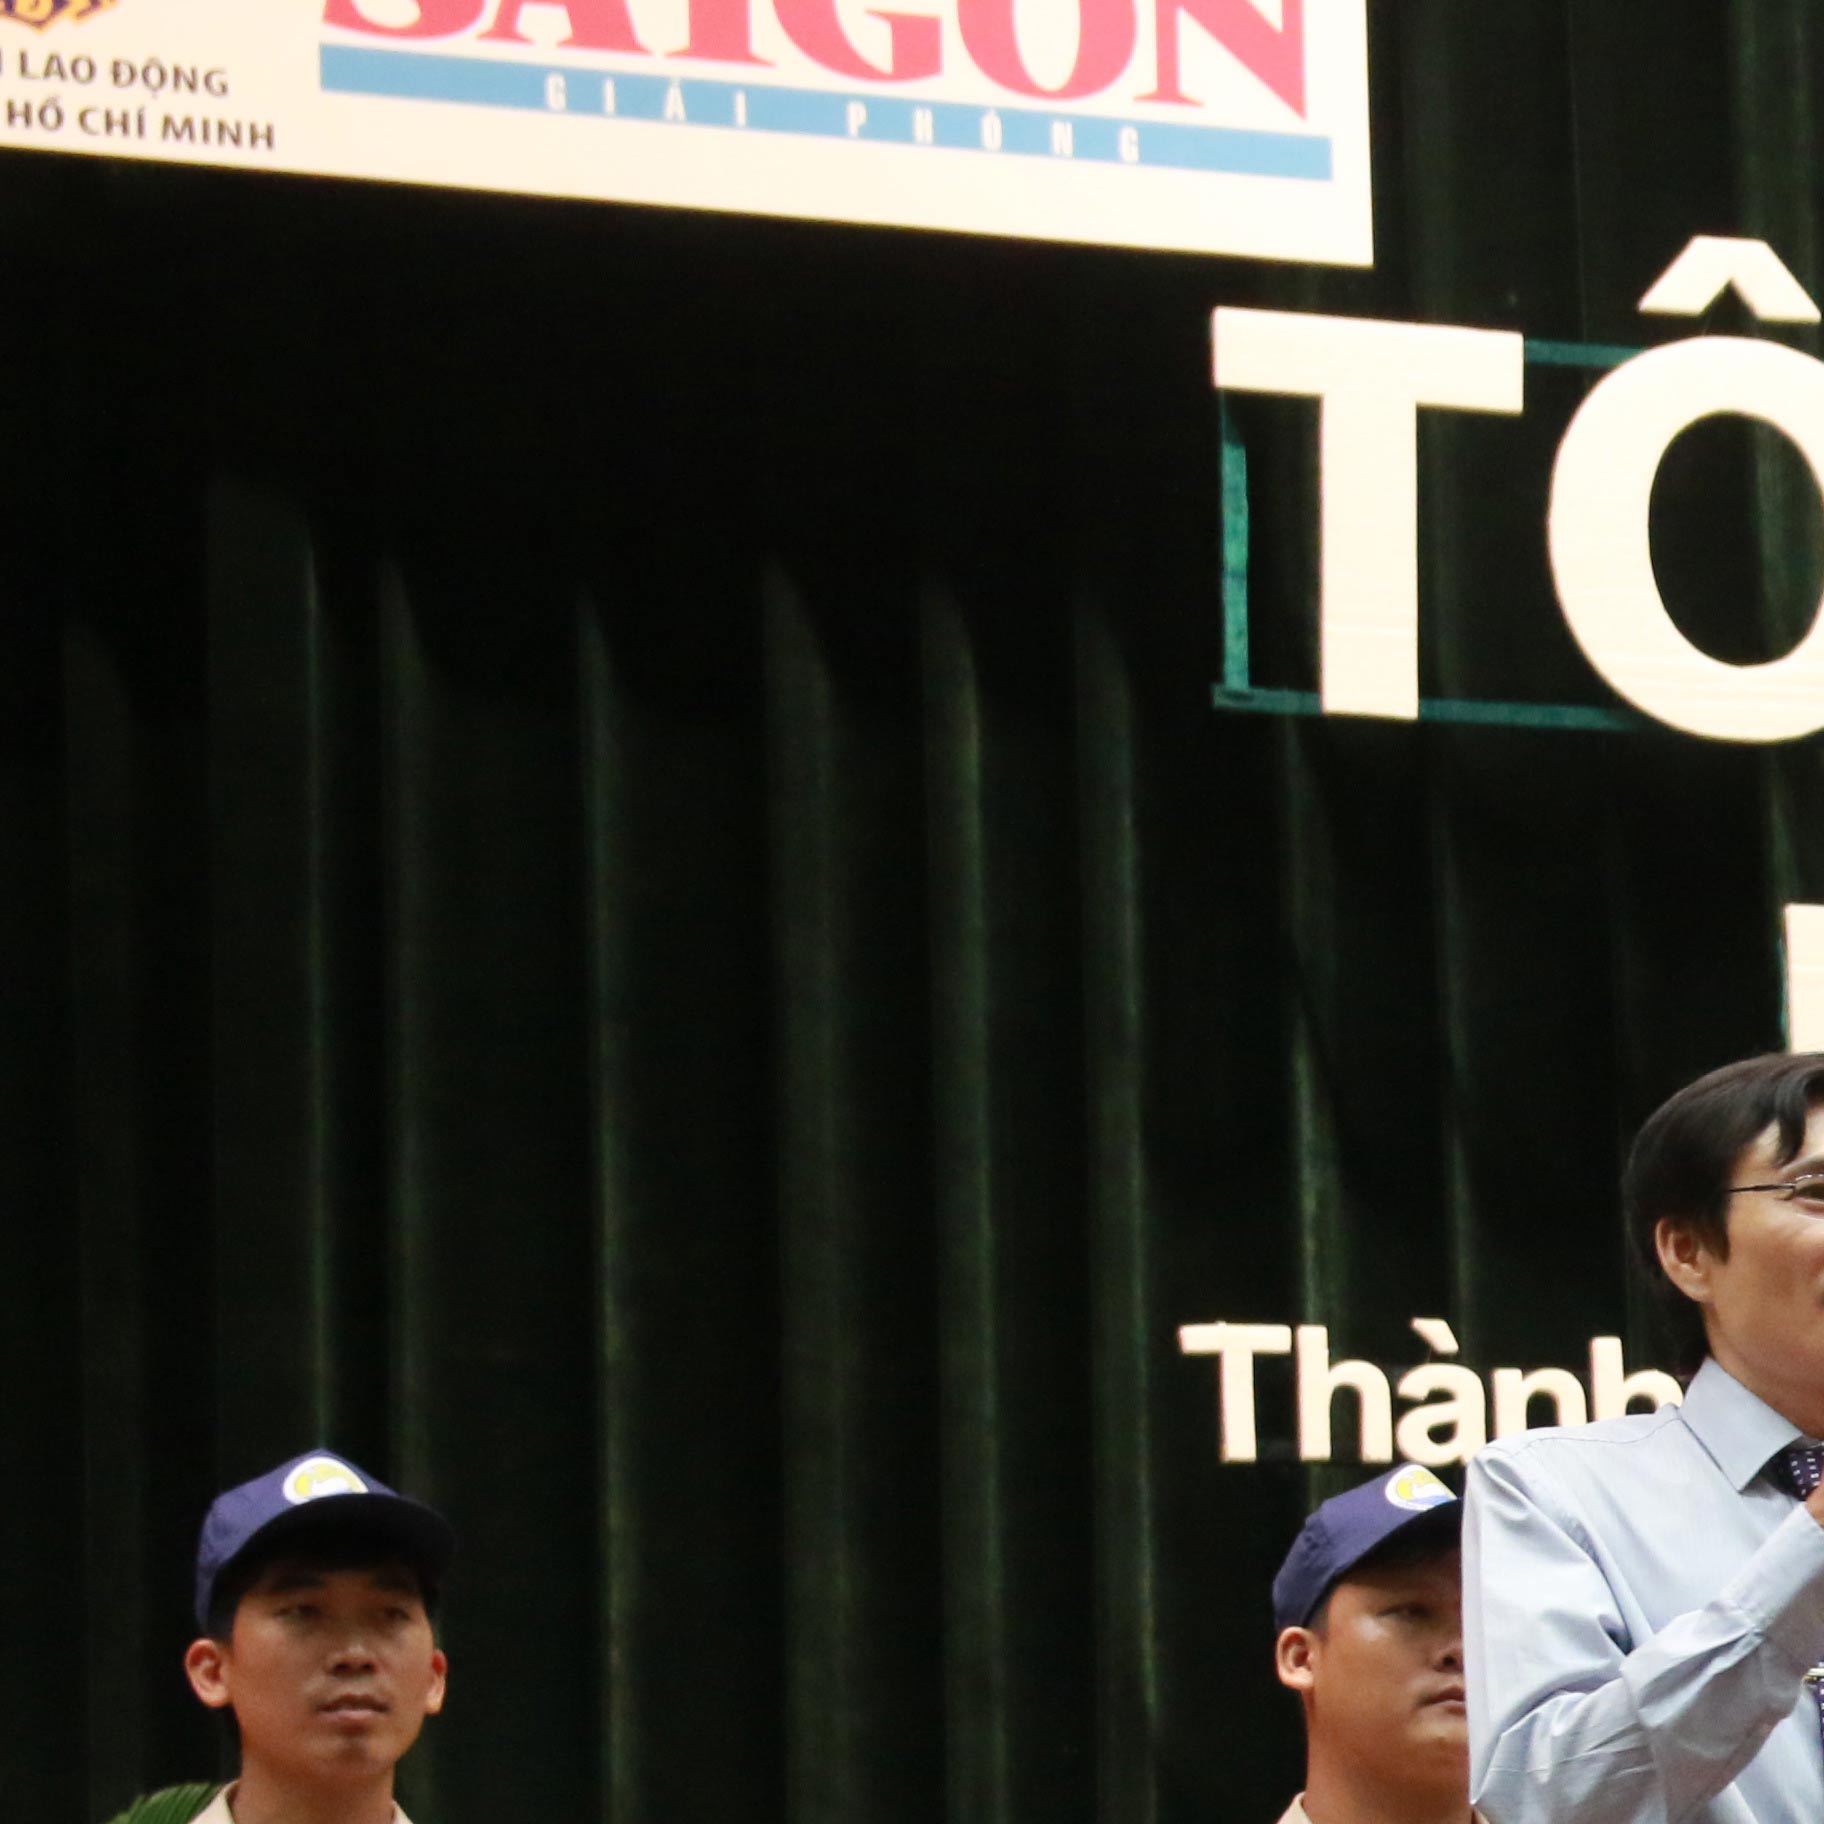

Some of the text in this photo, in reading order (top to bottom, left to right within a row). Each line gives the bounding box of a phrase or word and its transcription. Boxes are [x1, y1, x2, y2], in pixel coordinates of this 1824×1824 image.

[19, 48, 229, 98] LAO ĐỘNG
[79, 104, 146, 138] CHÍ
[161, 113, 276, 150] MINH
[1177, 1317, 1684, 1466] Thành
